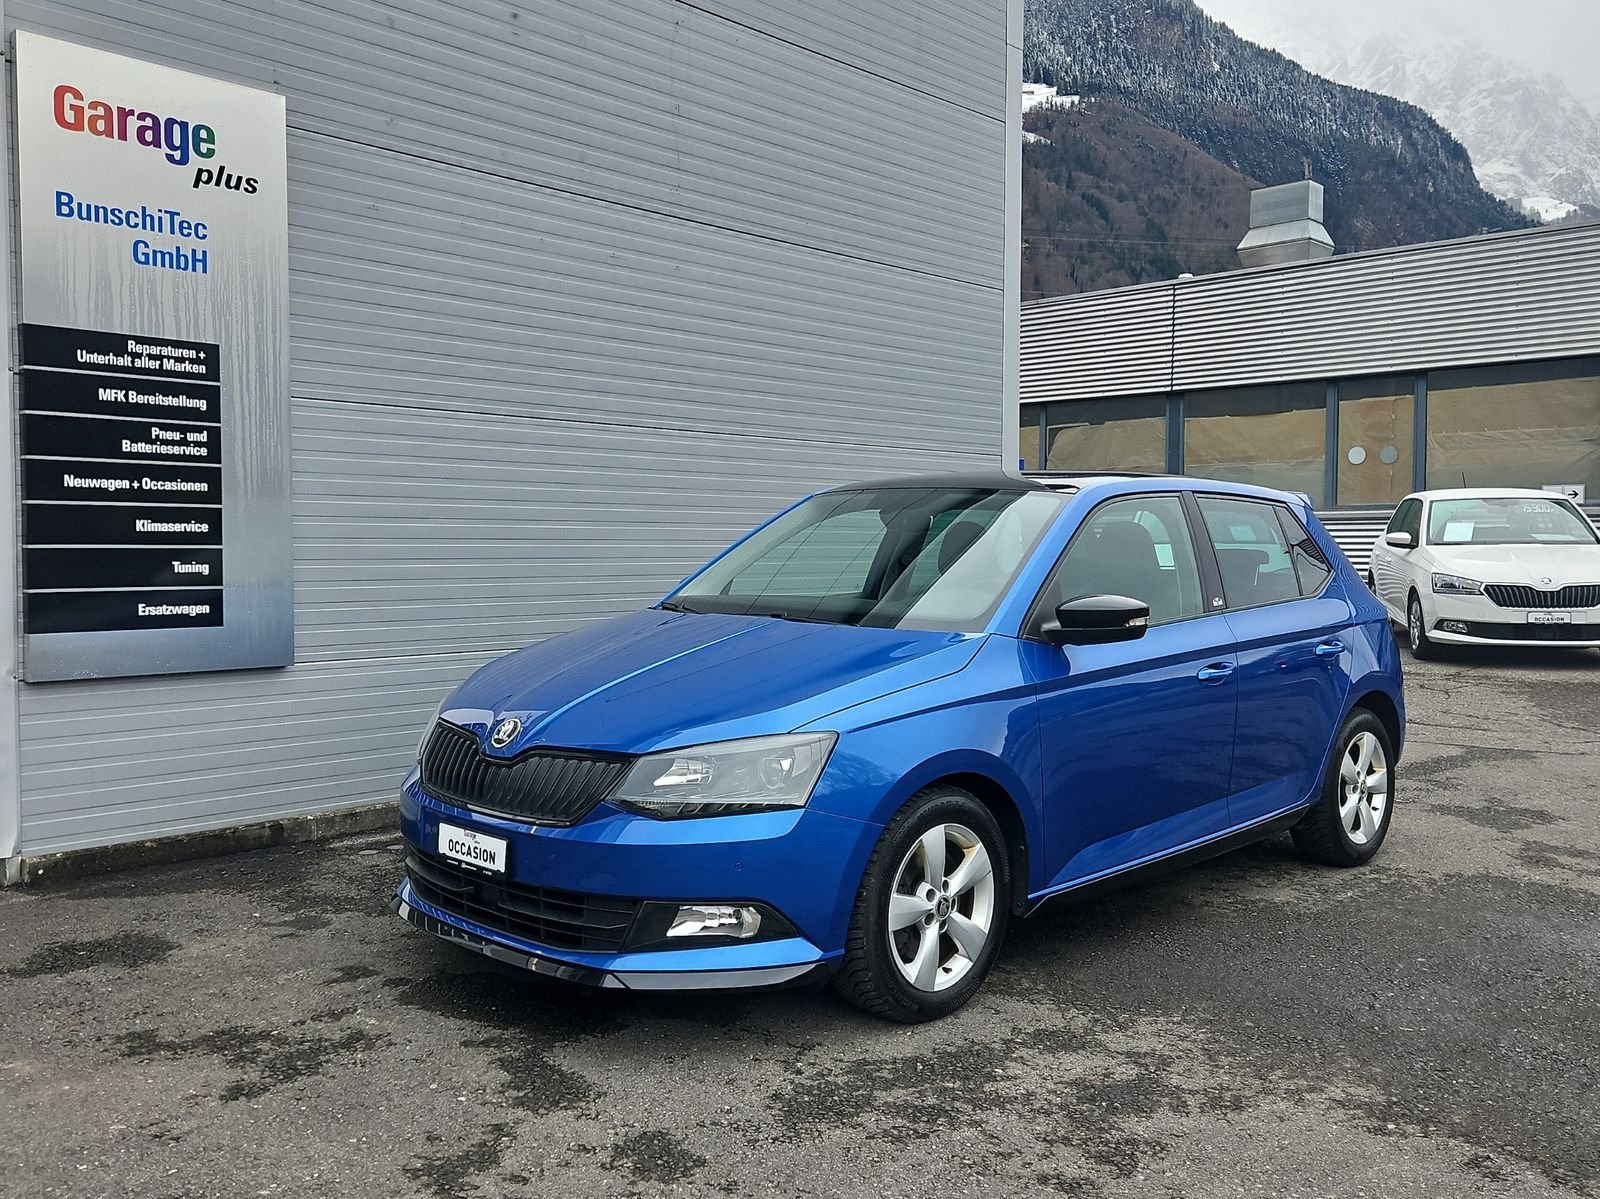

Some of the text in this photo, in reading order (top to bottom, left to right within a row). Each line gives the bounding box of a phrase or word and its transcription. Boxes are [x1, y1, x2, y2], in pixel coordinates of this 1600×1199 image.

[53, 84, 217, 166] Garage
[192, 165, 259, 195] plus
[55, 190, 208, 240] BunschiTec
[132, 239, 208, 274] GmbH
[127, 340, 206, 360] Reparaturen +
[77, 349, 207, 374] Unterhalt aller Marken
[98, 388, 207, 411] MFK Bereitstellung
[151, 427, 208, 442] Pneu- und
[122, 440, 208, 456] Batterieservice
[63, 474, 208, 492] Neuwagen + Occasionen
[135, 519, 209, 533] Klimaservice
[172, 561, 210, 575] Tuning
[138, 603, 210, 617] Ersatzwagen
[448, 838, 496, 866] OCCASION
